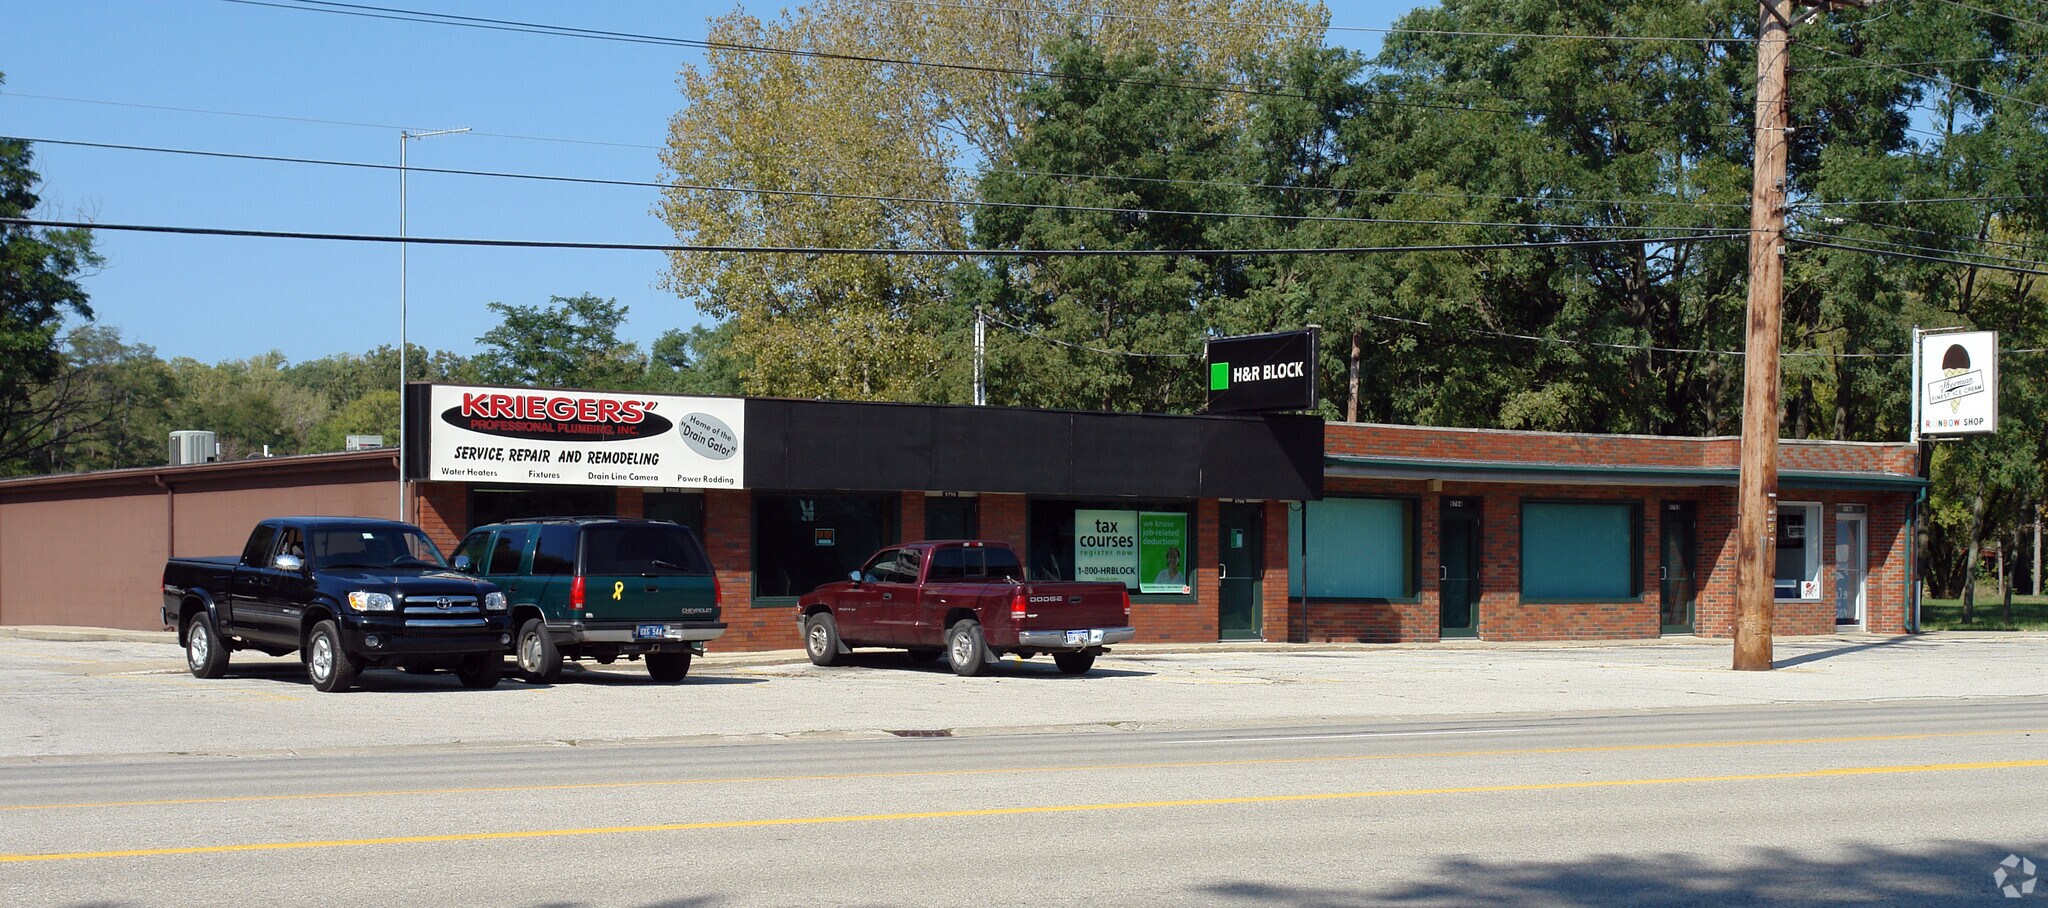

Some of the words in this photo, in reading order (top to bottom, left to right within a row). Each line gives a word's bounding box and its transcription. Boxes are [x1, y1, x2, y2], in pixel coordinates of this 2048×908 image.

[1233, 366, 1260, 383] H&R
[1263, 361, 1304, 380] BLOCK
[1931, 392, 1950, 401] FINEST
[1963, 385, 1982, 394] CREAM
[462, 393, 658, 423] KRIEGERS'
[471, 419, 555, 433] PROFESSIONAL
[557, 422, 614, 435] PLUMBING,
[617, 426, 640, 435] INC.
[1925, 418, 1960, 428] RINBOW
[1963, 417, 1984, 426] SHOP
[689, 415, 711, 432] Home
[712, 427, 721, 437] of
[721, 429, 733, 442] the
[680, 421, 706, 445] "Drain
[707, 437, 736, 457] Gator"
[454, 445, 505, 462] SERVICE,
[509, 448, 550, 463] REPAIR
[558, 450, 582, 463] AND
[587, 450, 659, 466] REMODELING
[441, 467, 465, 476] Water
[467, 468, 498, 477] Heaters
[528, 470, 560, 479] Fixtures
[588, 471, 610, 480] Drain
[611, 472, 627, 480] Line
[629, 473, 659, 481] Camera
[677, 475, 702, 483] Power
[703, 475, 734, 486] Rodding
[1095, 519, 1118, 533] tax
[1143, 520, 1155, 528] we
[1155, 519, 1175, 528] know
[1142, 528, 1180, 538] job-related
[1080, 535, 1133, 548] courses
[1143, 537, 1179, 545] deductions
[1080, 549, 1113, 557] register
[1078, 566, 1136, 575] 1-800-HRBLOCK
